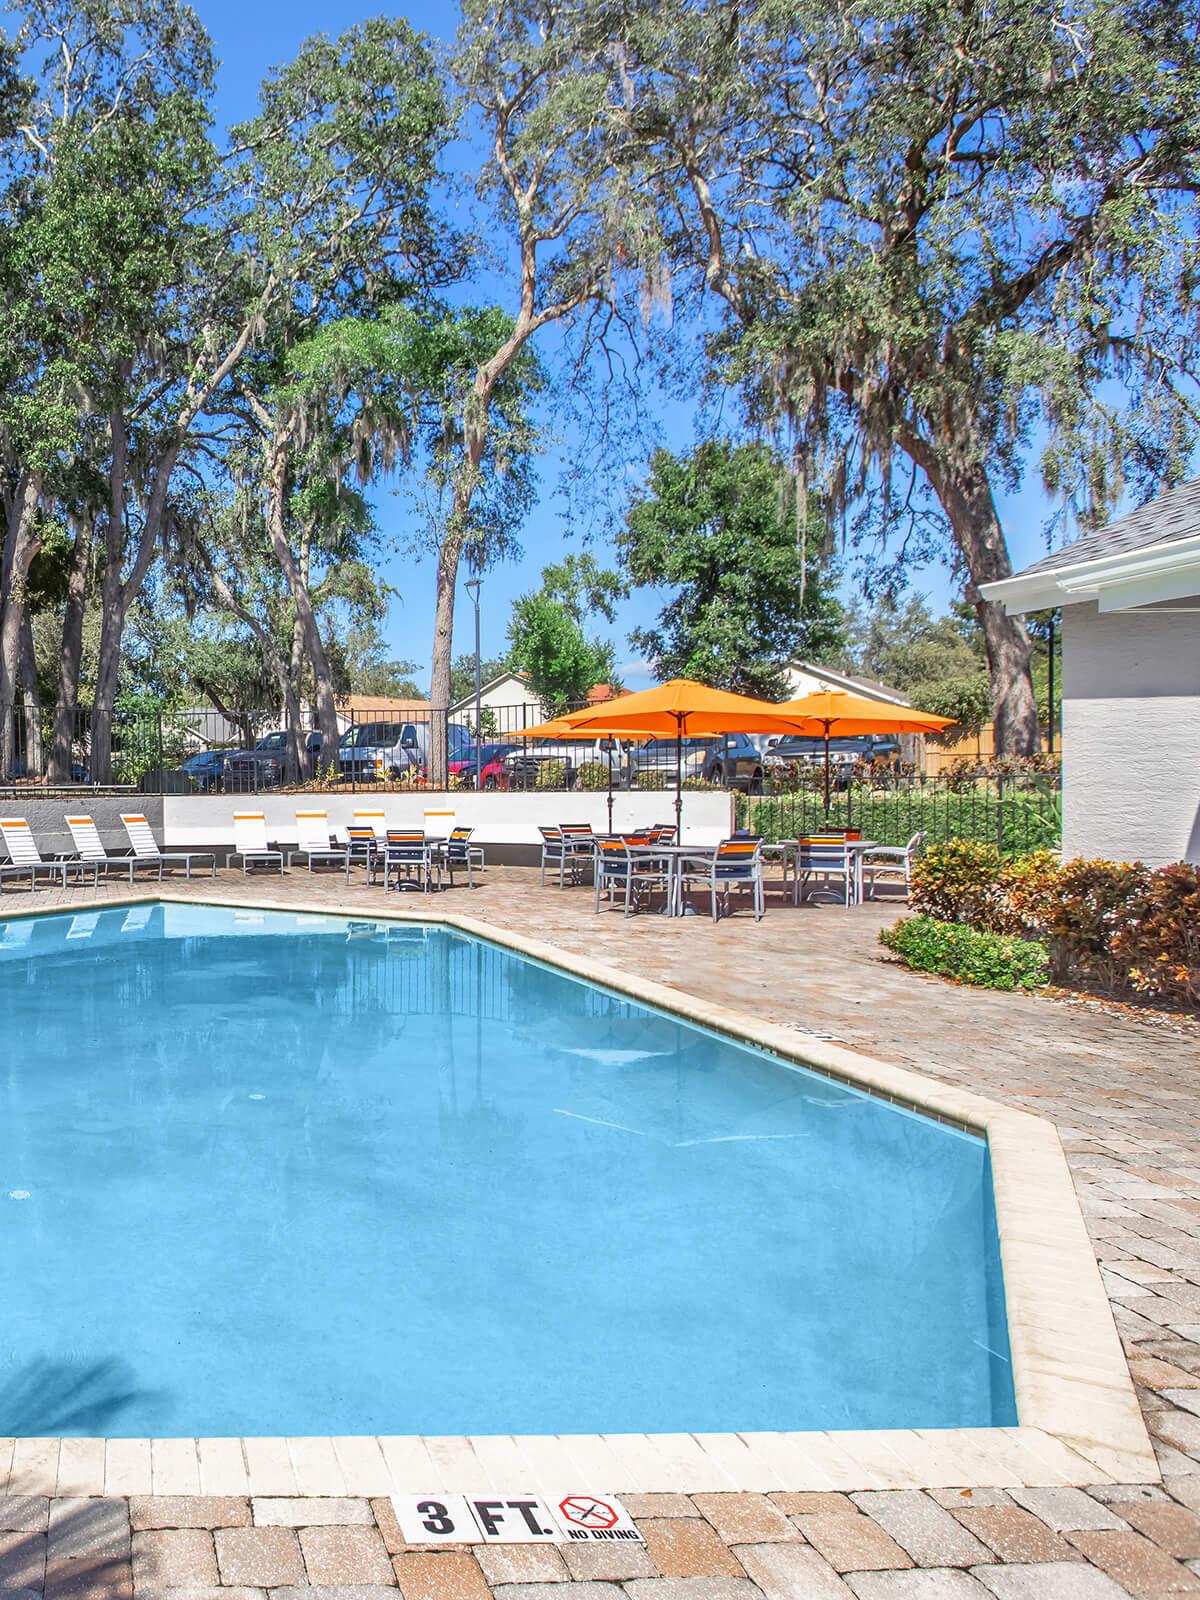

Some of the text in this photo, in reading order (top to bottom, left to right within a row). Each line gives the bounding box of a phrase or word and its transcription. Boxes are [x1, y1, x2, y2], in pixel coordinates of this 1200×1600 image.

[416, 1500, 554, 1536] 3 FT.
[567, 1529, 640, 1540] NO DIVING
